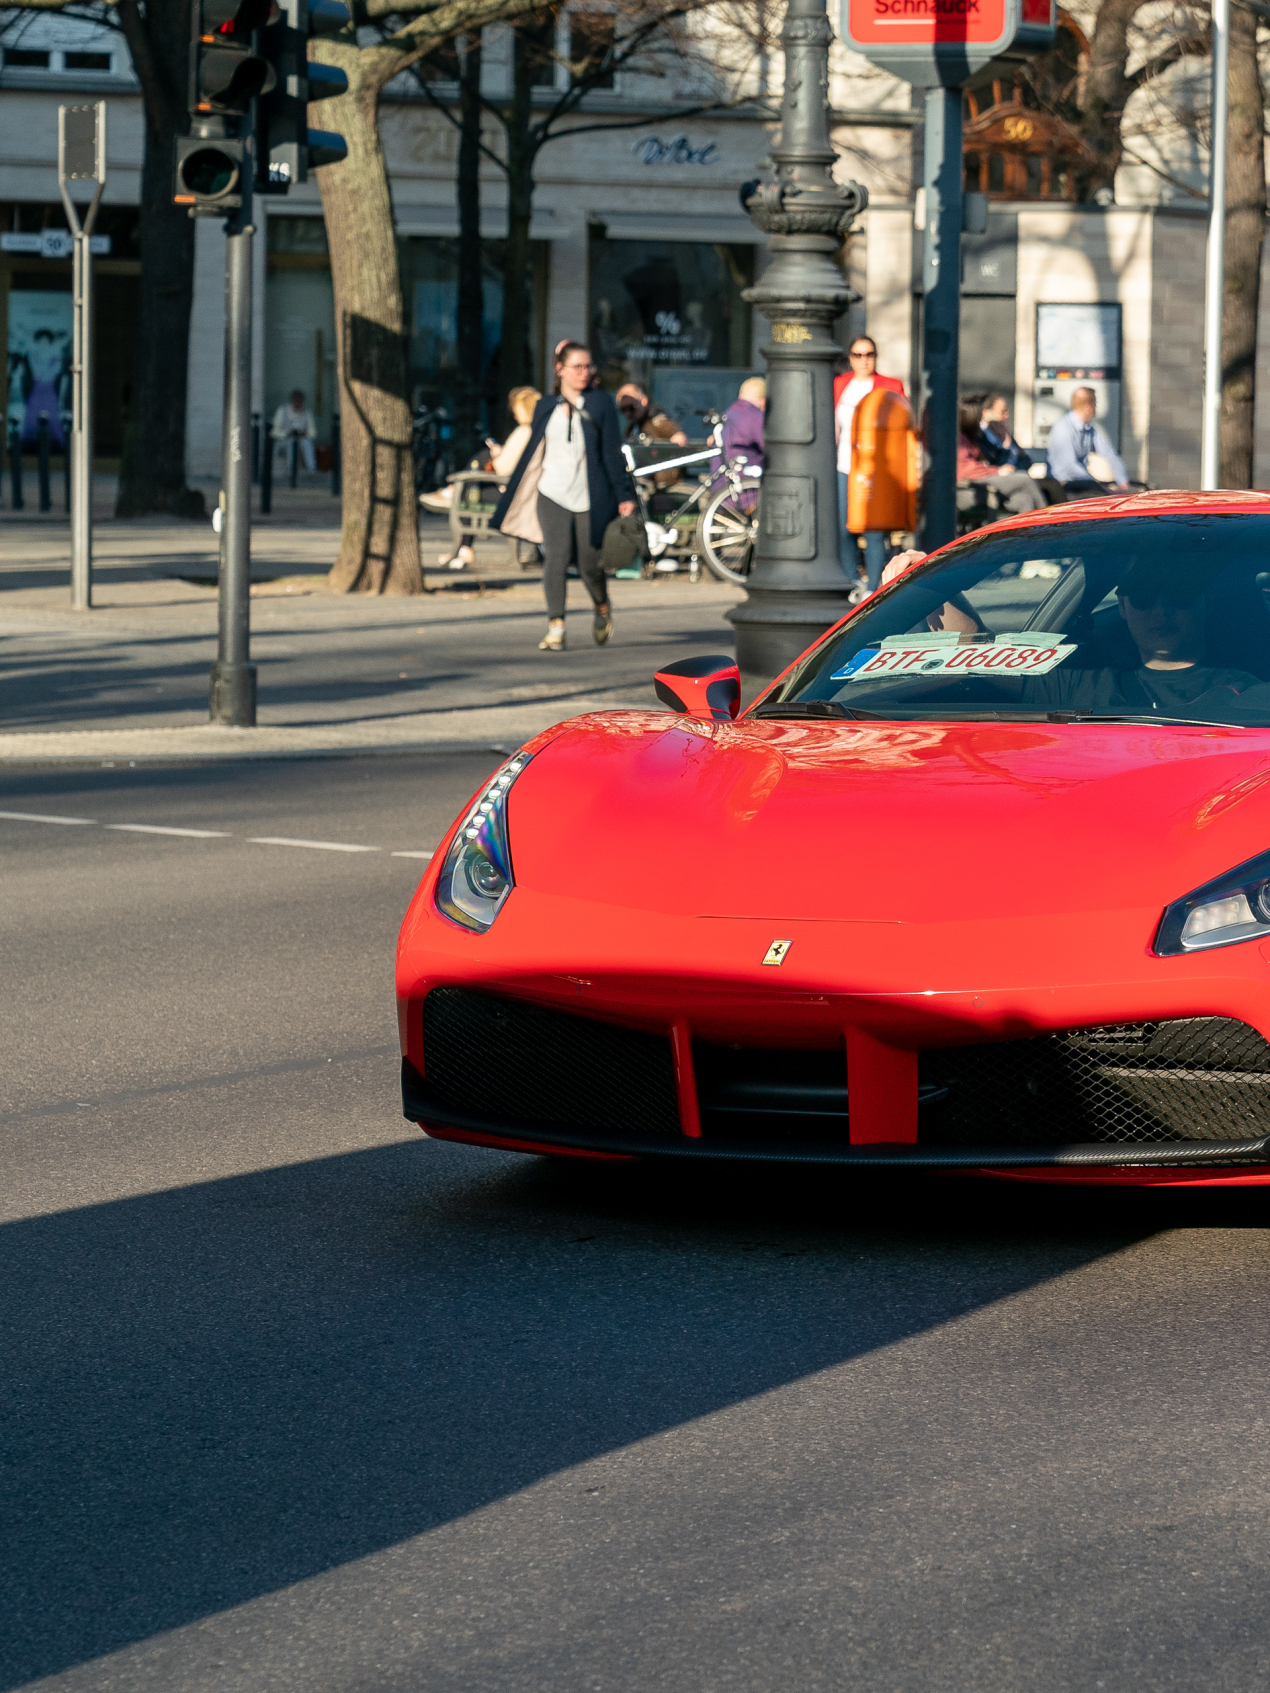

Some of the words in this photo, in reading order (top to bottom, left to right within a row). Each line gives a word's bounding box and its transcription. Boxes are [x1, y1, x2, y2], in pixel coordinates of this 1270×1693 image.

[1003, 117, 1033, 140] 50
[863, 649, 940, 672] BTF
[945, 647, 1058, 669] 06089
